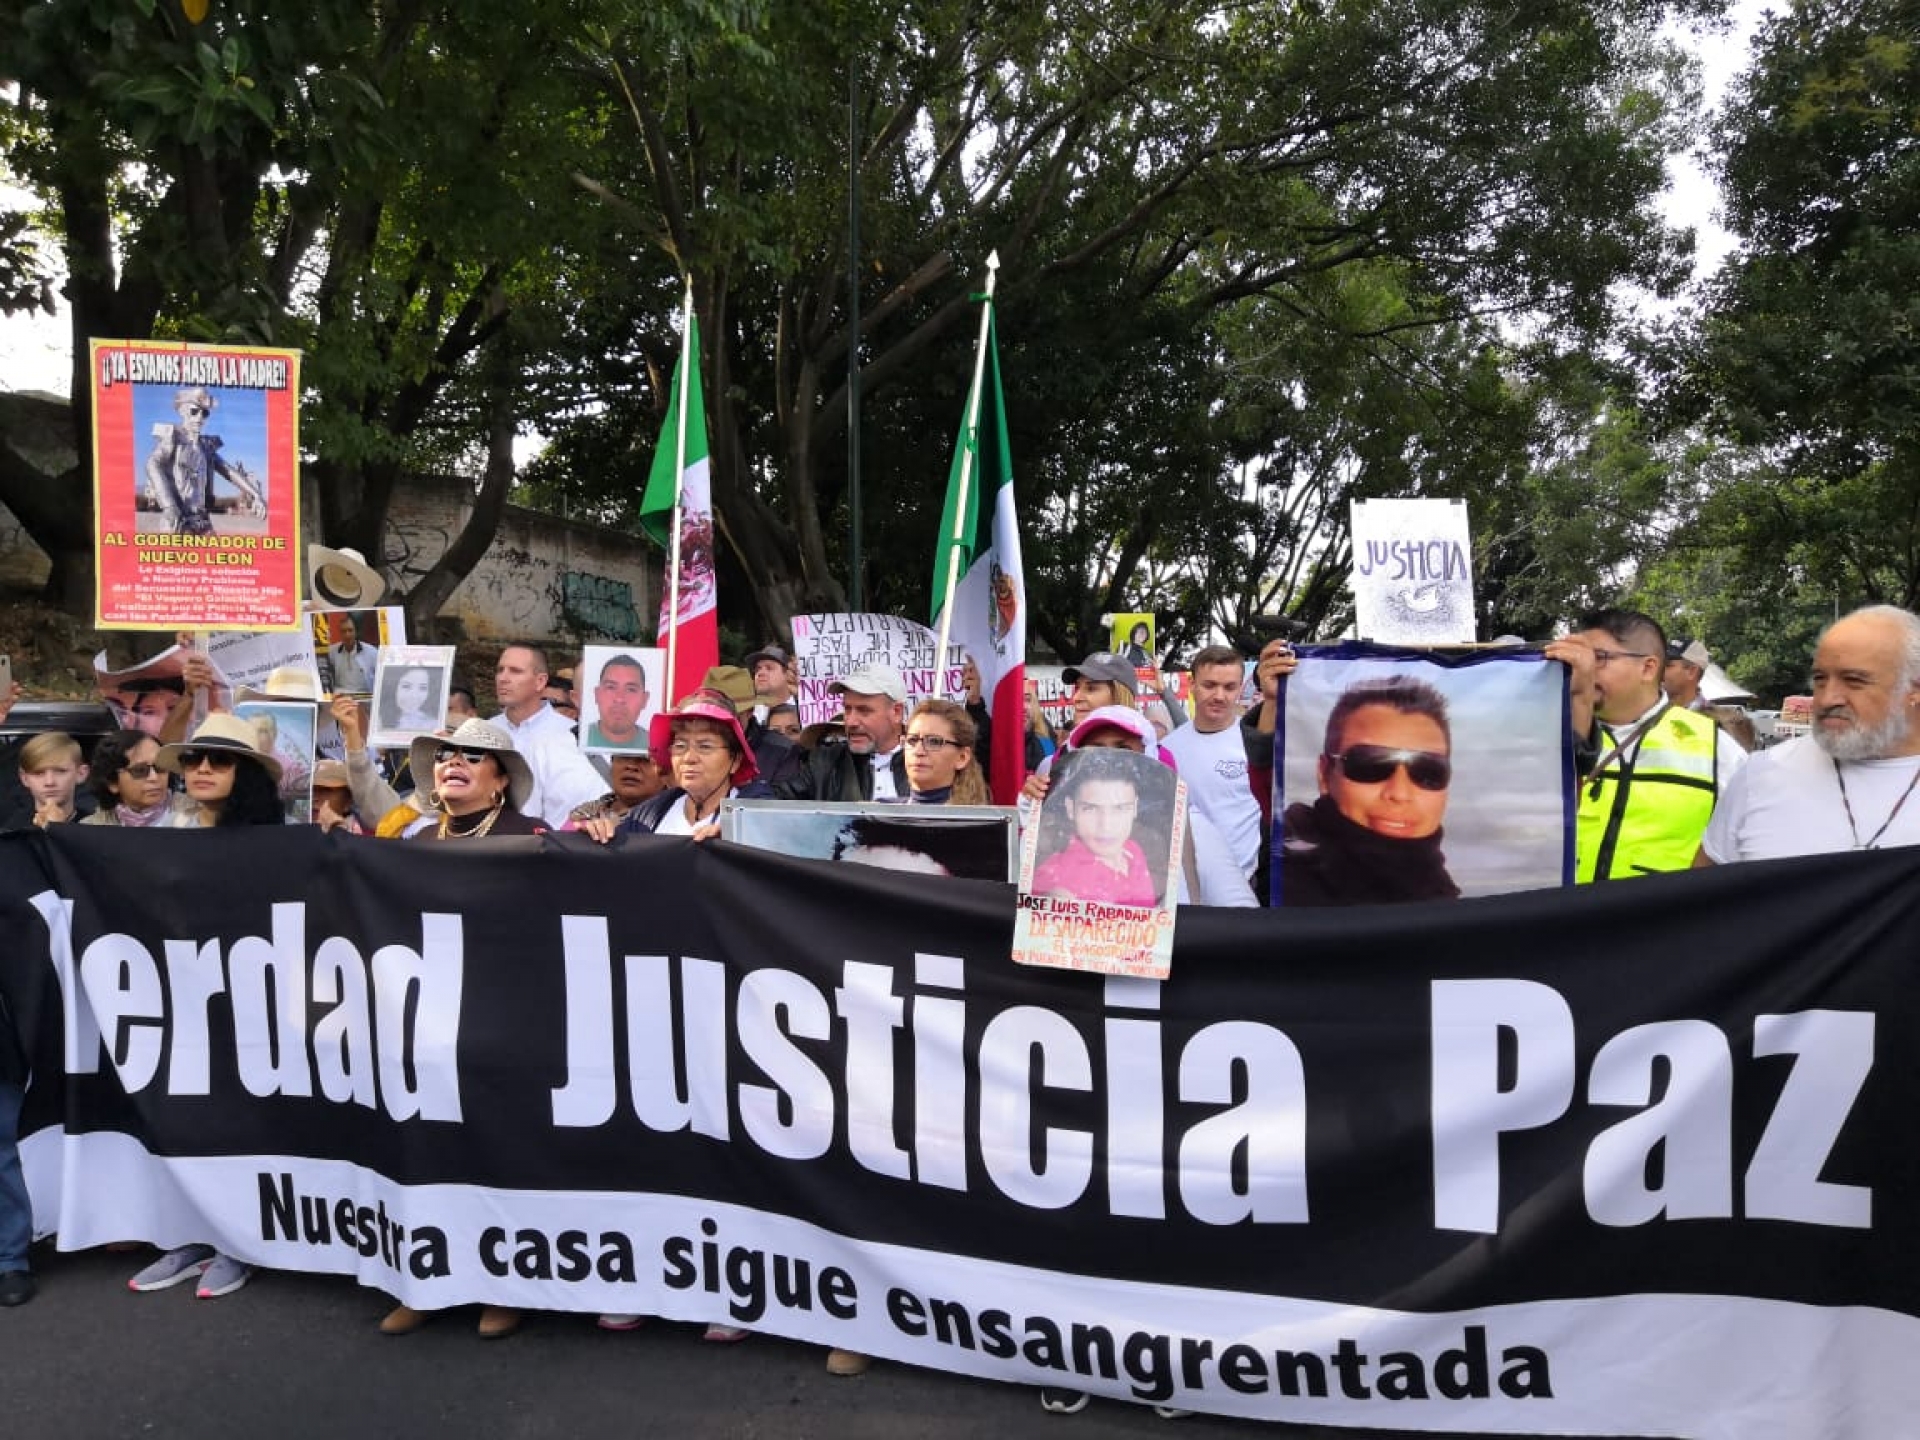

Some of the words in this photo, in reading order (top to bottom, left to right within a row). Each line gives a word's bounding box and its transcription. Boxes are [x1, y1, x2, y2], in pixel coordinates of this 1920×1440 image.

[130, 353, 181, 384] ESTAMOS
[182, 355, 221, 386] HASTA
[222, 357, 239, 388] LA
[104, 533, 127, 546] AL
[134, 534, 257, 549] GOBERNADOR
[262, 537, 286, 549] DE
[139, 551, 200, 564] NUEVO
[206, 552, 253, 565] LEON
[1360, 540, 1467, 581] JUSTICIA
[201, 577, 256, 585] Problema
[810, 635, 851, 656] PASE
[867, 632, 890, 651] ME
[800, 656, 817, 678] DE
[897, 648, 935, 670] ERES
[1017, 893, 1048, 911] JOSE
[1051, 899, 1079, 914] LUIS
[1085, 903, 1151, 922] RABADAN
[1029, 911, 1159, 948] DESAPARECIDO
[550, 914, 1310, 1226] Justicia
[1430, 978, 1876, 1234] Paz
[257, 1172, 451, 1280] Nuestra
[479, 1225, 637, 1282] casa
[663, 1217, 858, 1322] sigue
[886, 1285, 1554, 1401] ensangrentada
